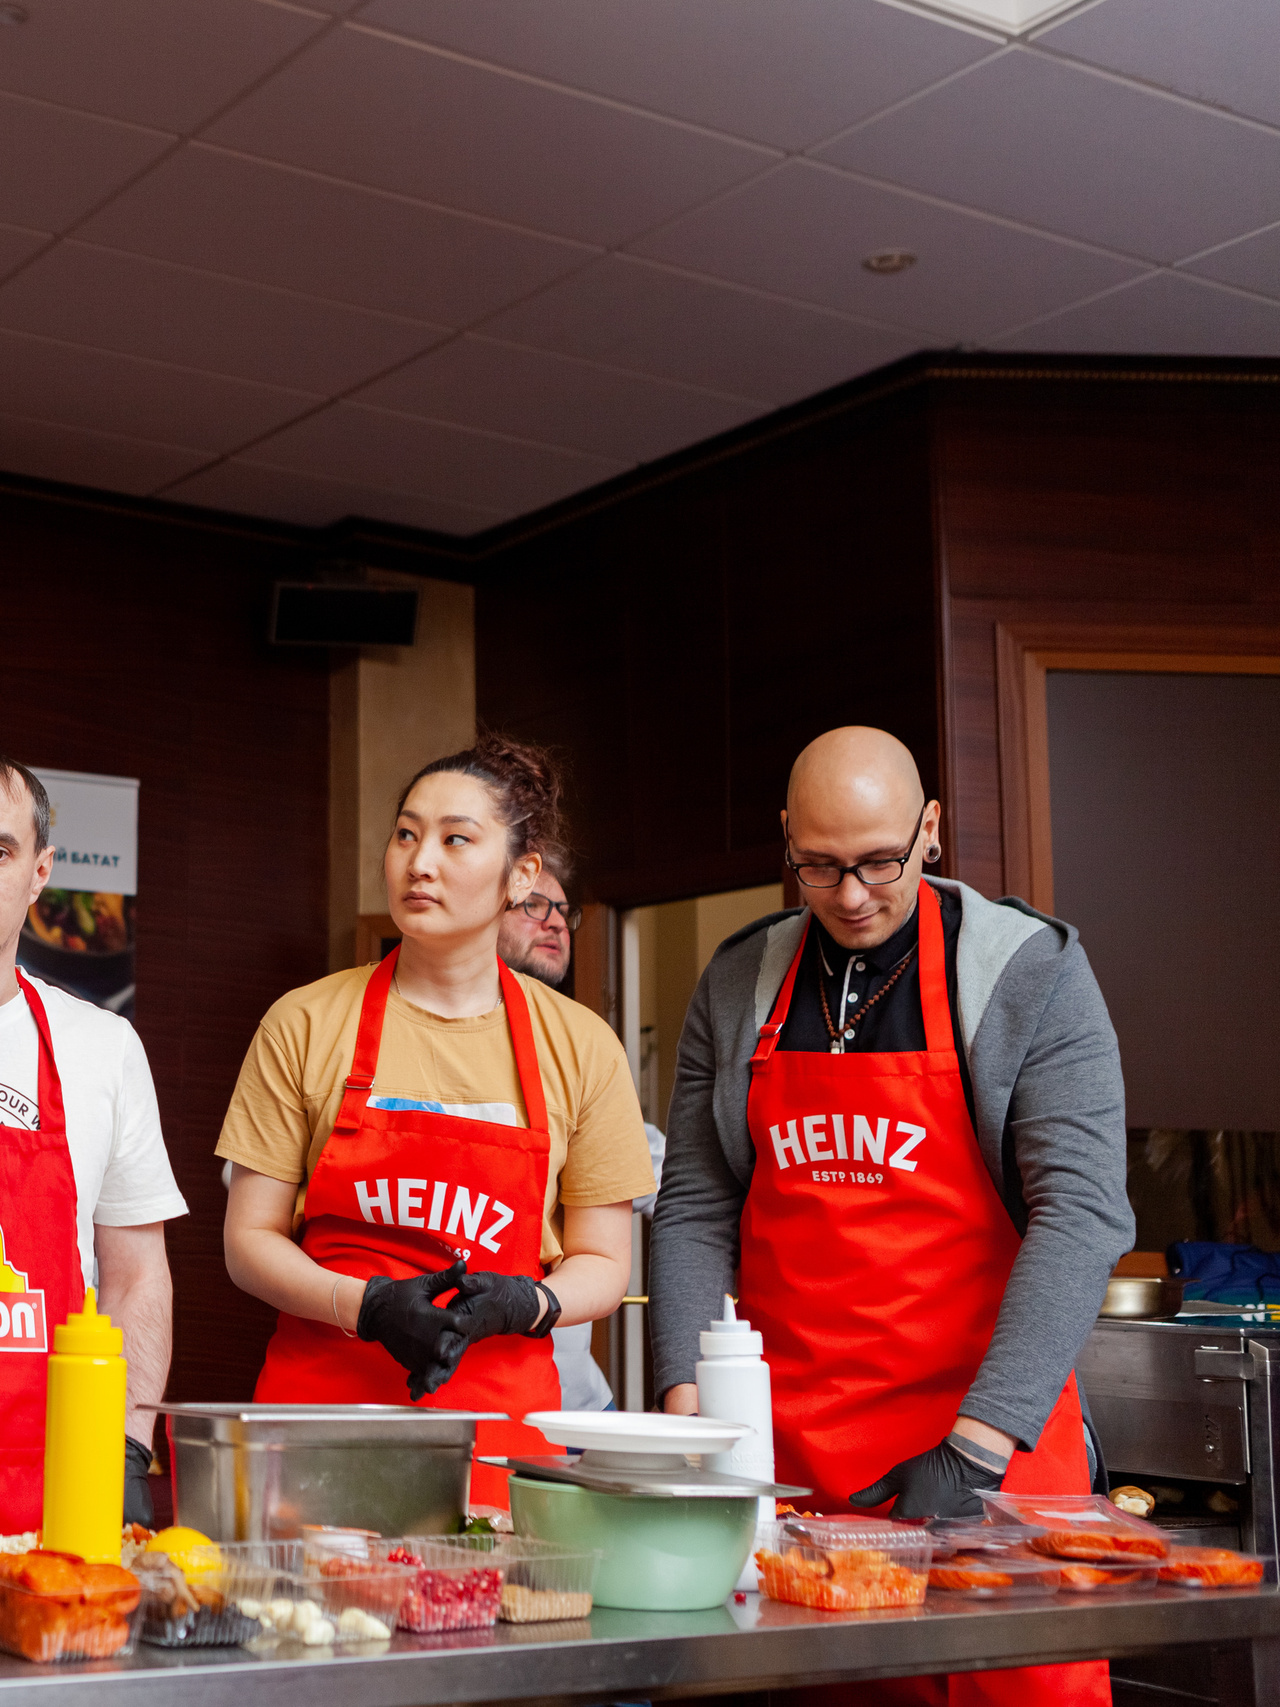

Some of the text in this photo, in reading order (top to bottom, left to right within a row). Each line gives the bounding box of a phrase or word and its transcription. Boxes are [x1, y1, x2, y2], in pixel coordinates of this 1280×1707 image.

[71, 851, 119, 868] БАТАТ
[769, 1114, 927, 1172] HEINZ
[849, 1172, 884, 1184] 1869
[354, 1178, 515, 1254] HEINZ
